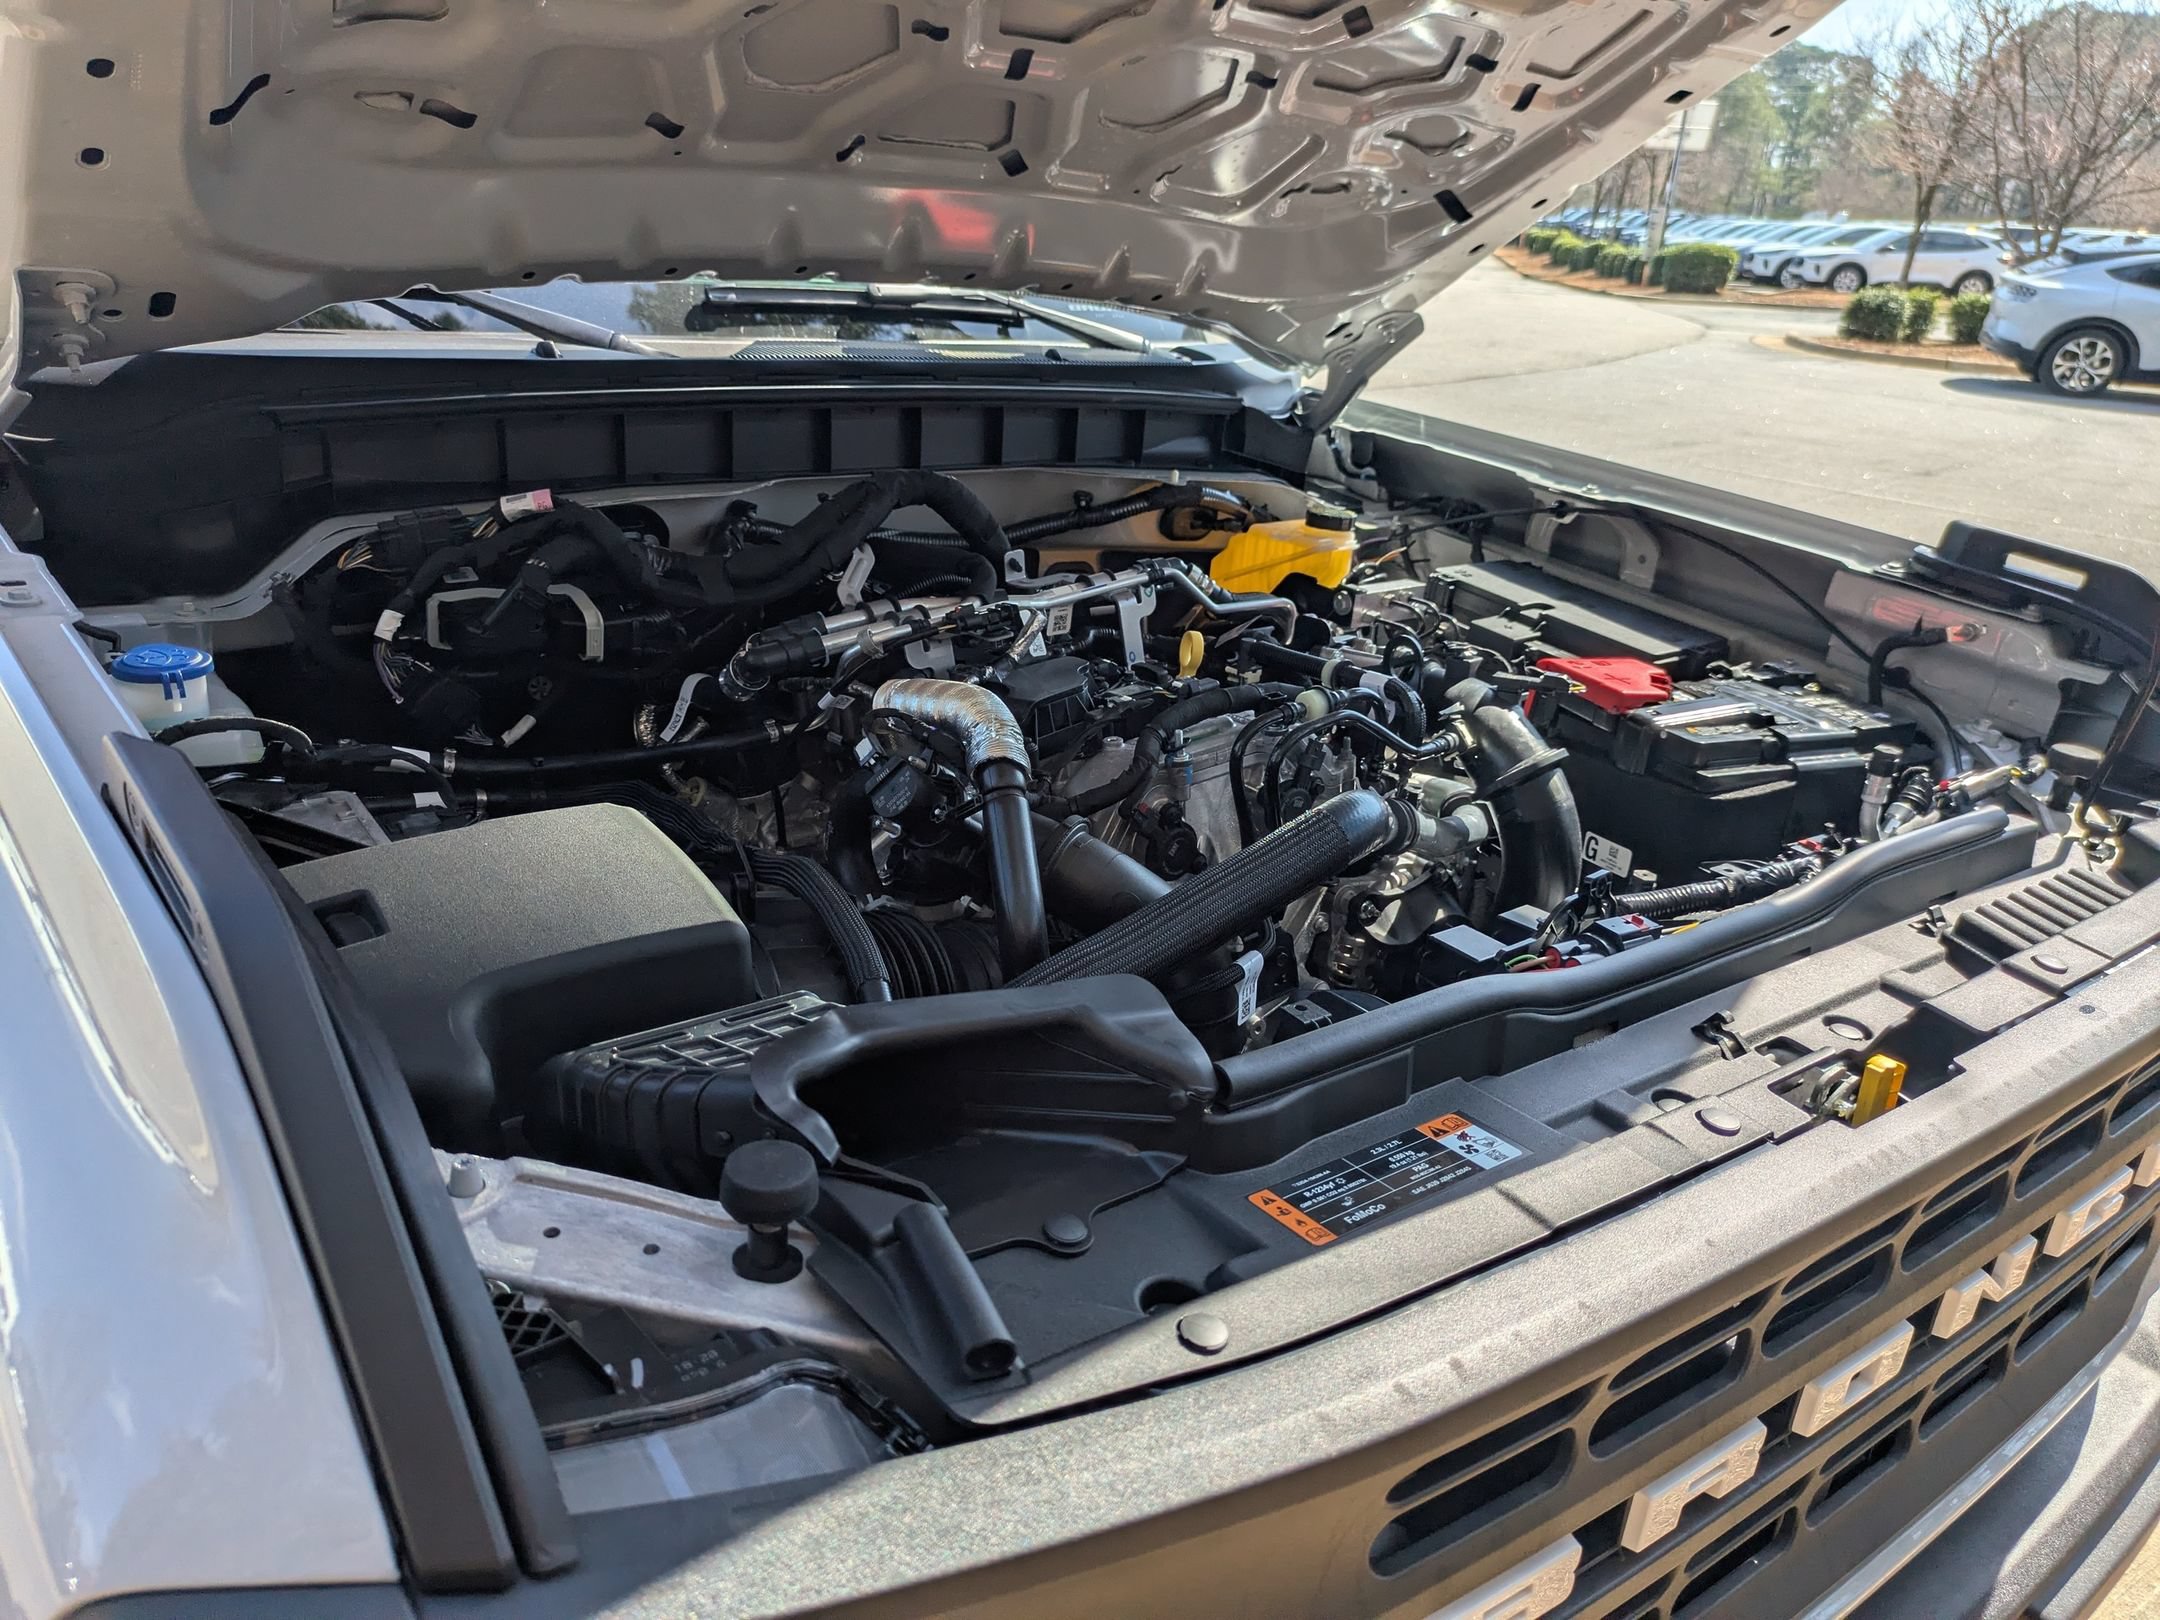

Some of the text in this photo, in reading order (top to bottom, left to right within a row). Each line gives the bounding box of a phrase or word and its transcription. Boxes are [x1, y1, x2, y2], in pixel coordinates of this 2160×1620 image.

[1585, 836, 1599, 861] G
[1411, 1162, 1429, 1173] PAG
[1411, 1186, 1426, 1195] SAE
[1343, 1203, 1386, 1224] FoMoCo
[1422, 1142, 2160, 1620] BRONC
